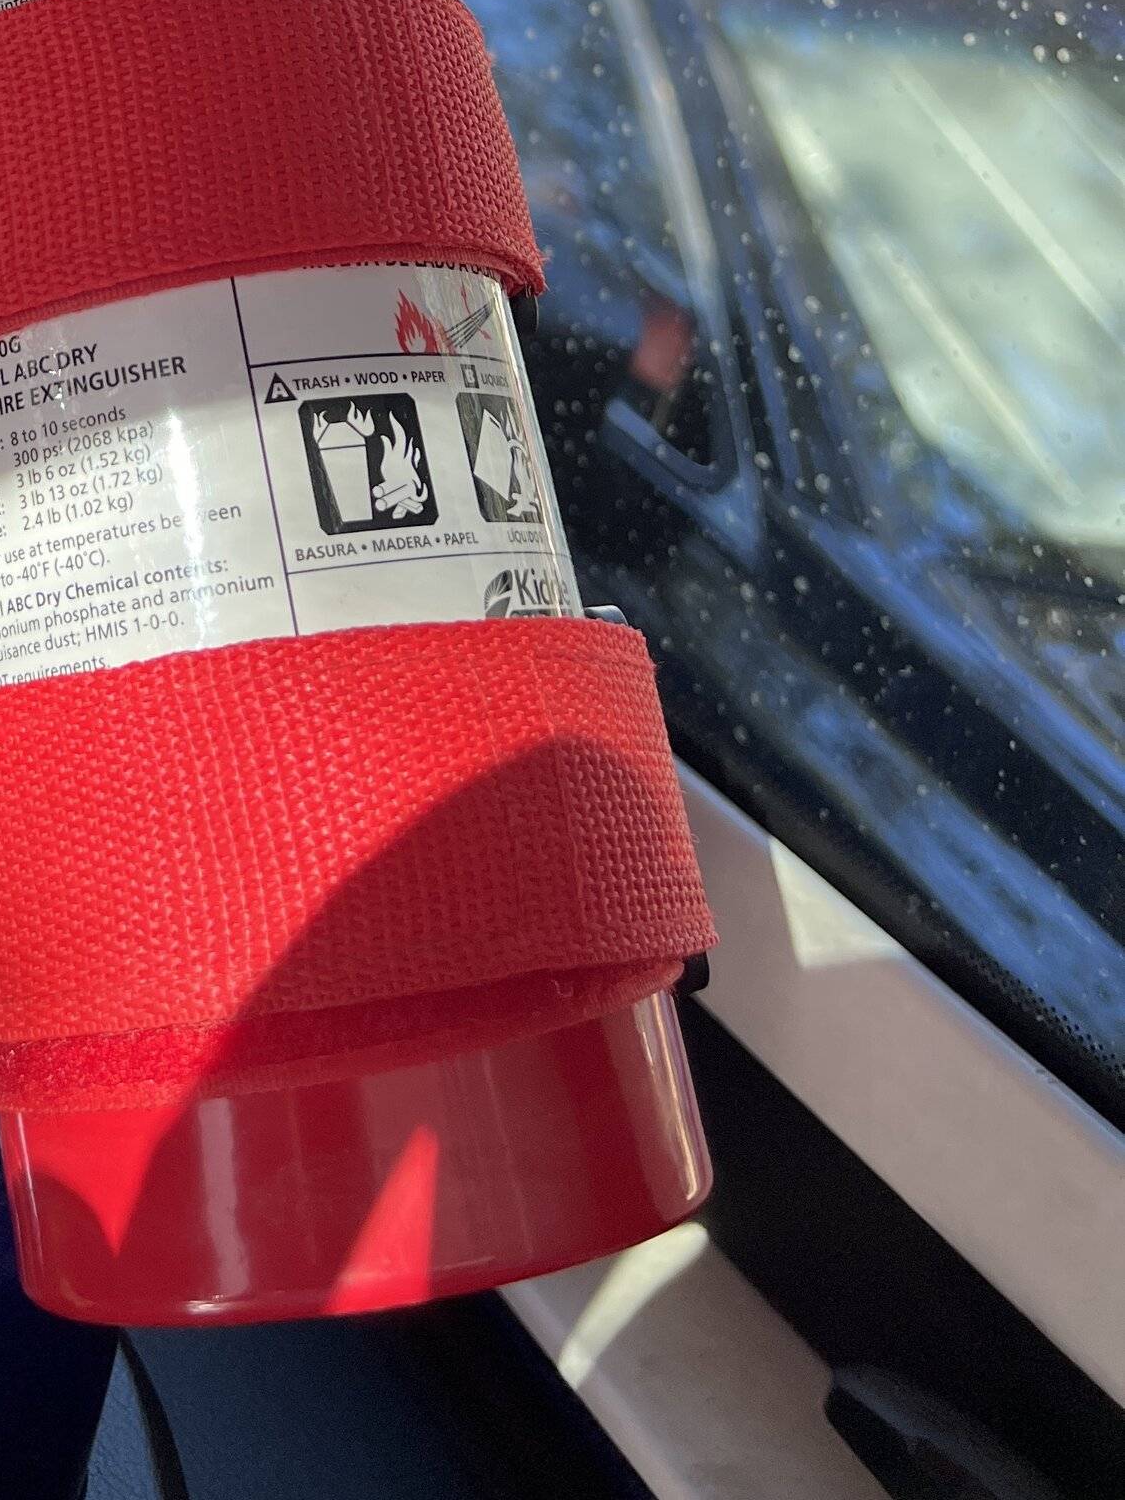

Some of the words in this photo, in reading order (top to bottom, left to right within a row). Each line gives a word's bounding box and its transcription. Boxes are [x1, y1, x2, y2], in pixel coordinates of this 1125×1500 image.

[14, 354, 51, 382] ABC
[56, 343, 97, 370] DRY
[30, 356, 187, 406] EXTINGUISHER
[292, 371, 340, 391] TRASH
[354, 370, 399, 386] WOOD
[411, 370, 446, 384] PAPER
[10, 431, 19, 446] 8
[22, 429, 37, 443] to
[42, 420, 58, 437] 10
[62, 405, 126, 433] seconds
[13, 447, 39, 467] 300
[67, 429, 112, 456] (2068
[116, 420, 154, 444] kpa)
[17, 473, 24, 488] 3
[28, 468, 42, 485] lb
[45, 465, 54, 481] 6
[58, 463, 76, 478] oz
[81, 450, 120, 475] (1.52
[124, 444, 152, 465] kg)
[19, 494, 28, 510] 3
[31, 490, 45, 507] lb
[49, 484, 65, 501] 13
[70, 482, 89, 497] oz
[92, 470, 131, 494] (1.72
[136, 463, 164, 485] kg)
[22, 511, 43, 531] 2.4
[48, 505, 62, 525] lb
[65, 498, 103, 523] (1.02
[107, 491, 134, 513] kg)
[4, 548, 26, 564] use
[29, 541, 43, 558] at
[46, 519, 156, 553] temperatures
[294, 542, 357, 562] BASURA
[371, 534, 433, 552] MADERA
[443, 532, 480, 546] PAPEL
[1, 573, 14, 588] to
[16, 560, 50, 582] -40°F
[54, 548, 111, 578] (-40°C).
[7, 594, 34, 615] ABC
[36, 590, 61, 608] Dry
[65, 571, 139, 601] Chemical
[44, 601, 126, 630] phosphate
[131, 589, 165, 612] and
[45, 630, 81, 651] dust;
[85, 619, 129, 643] HMIS
[133, 610, 185, 633] 1-0-0.
